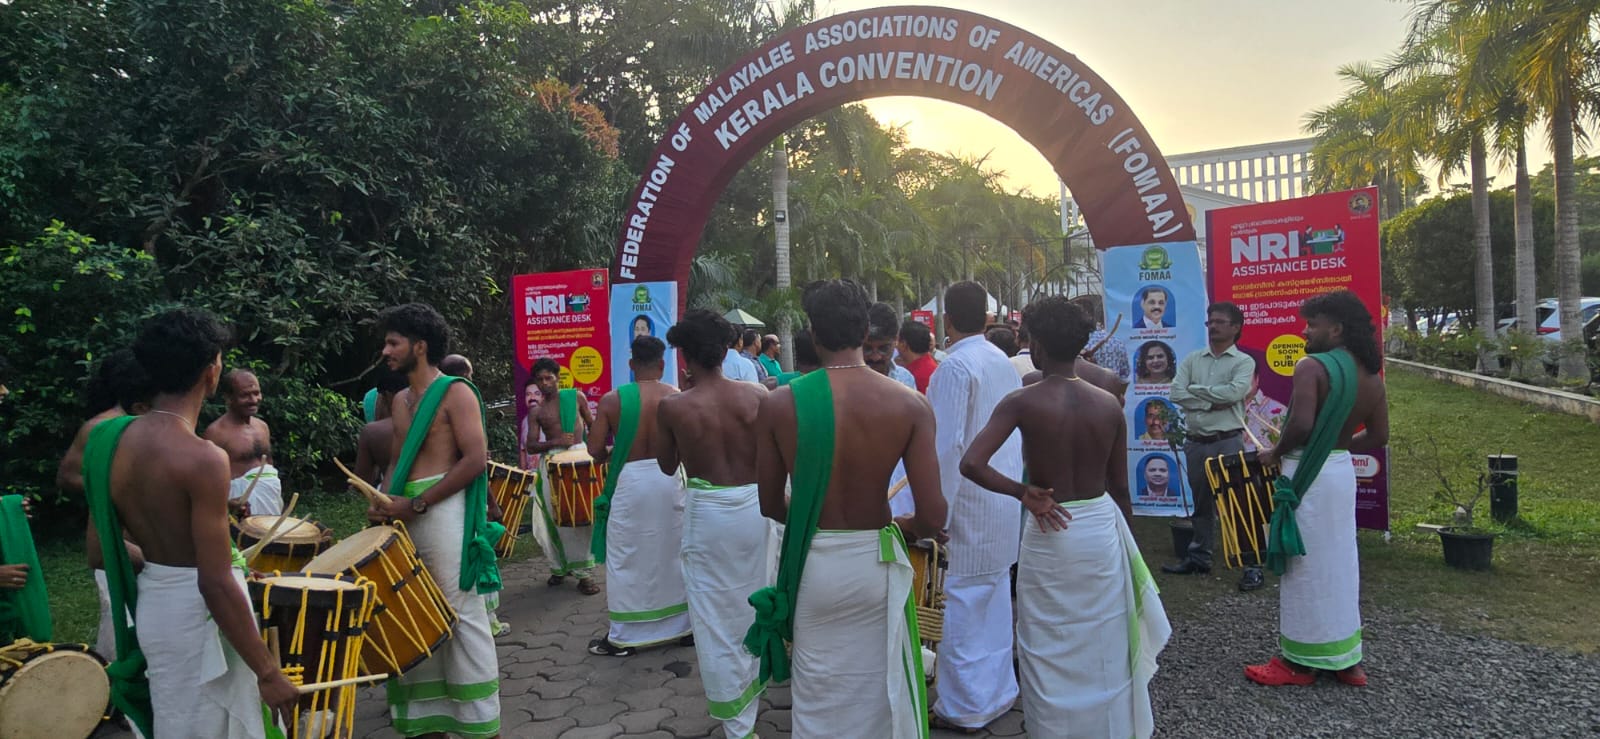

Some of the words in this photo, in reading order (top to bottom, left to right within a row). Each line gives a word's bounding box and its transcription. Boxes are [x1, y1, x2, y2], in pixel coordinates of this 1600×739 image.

[713, 71, 815, 150] KERALA
[819, 52, 1004, 101] CONVENTION
[620, 153, 676, 280] FEDERATION
[671, 121, 693, 152] OF
[693, 41, 796, 127] MALAYALEE
[805, 15, 959, 55] ASSOCIATIONS
[968, 25, 1001, 52] OF
[1004, 40, 1114, 127] AMERICAS
[1107, 127, 1184, 239] (FOMAA)
[1231, 230, 1300, 264] NRI
[1138, 271, 1171, 281] FOMAA
[1232, 260, 1307, 277] ASSISTANCE
[1311, 256, 1346, 270] DESK
[525, 294, 566, 316] NRI
[632, 303, 652, 312] FOMAA
[527, 315, 570, 325] ASSISTANCE
[572, 314, 591, 323] DESK
